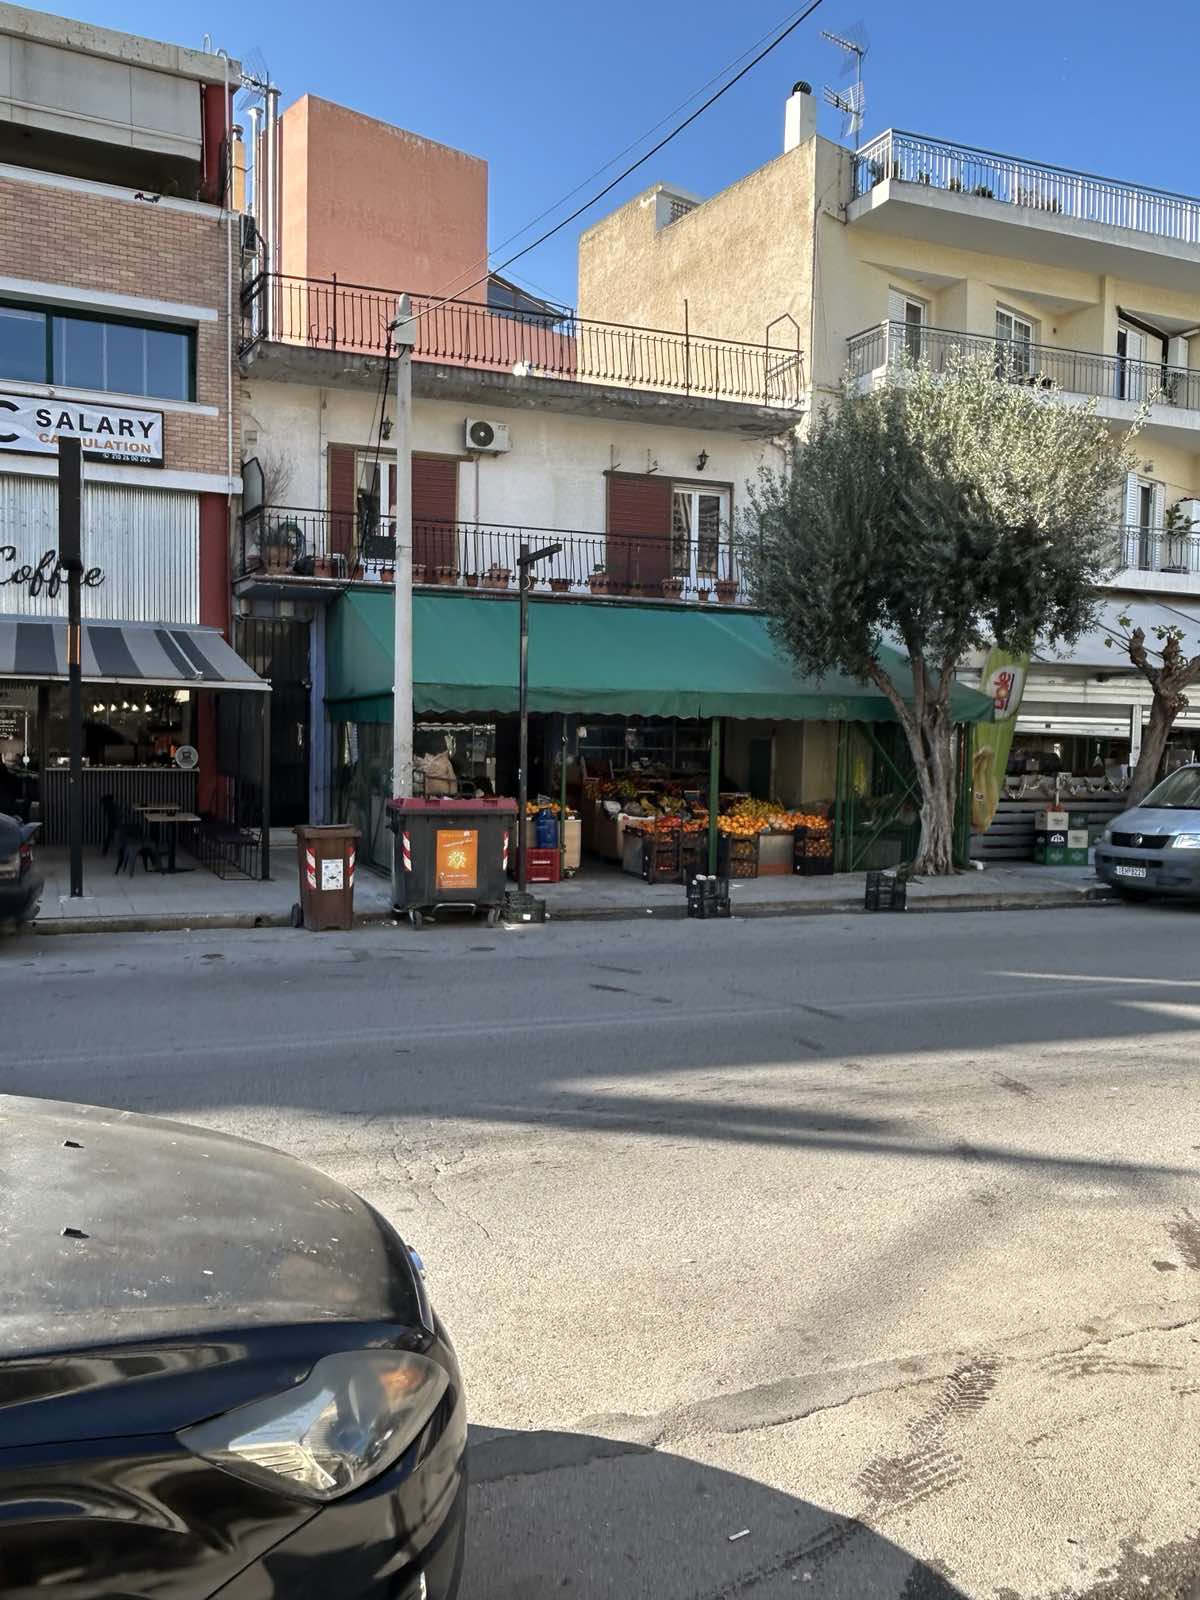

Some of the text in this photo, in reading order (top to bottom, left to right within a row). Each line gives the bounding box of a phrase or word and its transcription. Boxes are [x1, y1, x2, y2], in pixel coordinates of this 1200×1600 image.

[36, 409, 154, 439] SALARY
[38, 432, 152, 454] CAULATION
[0, 546, 105, 597] Coffe
